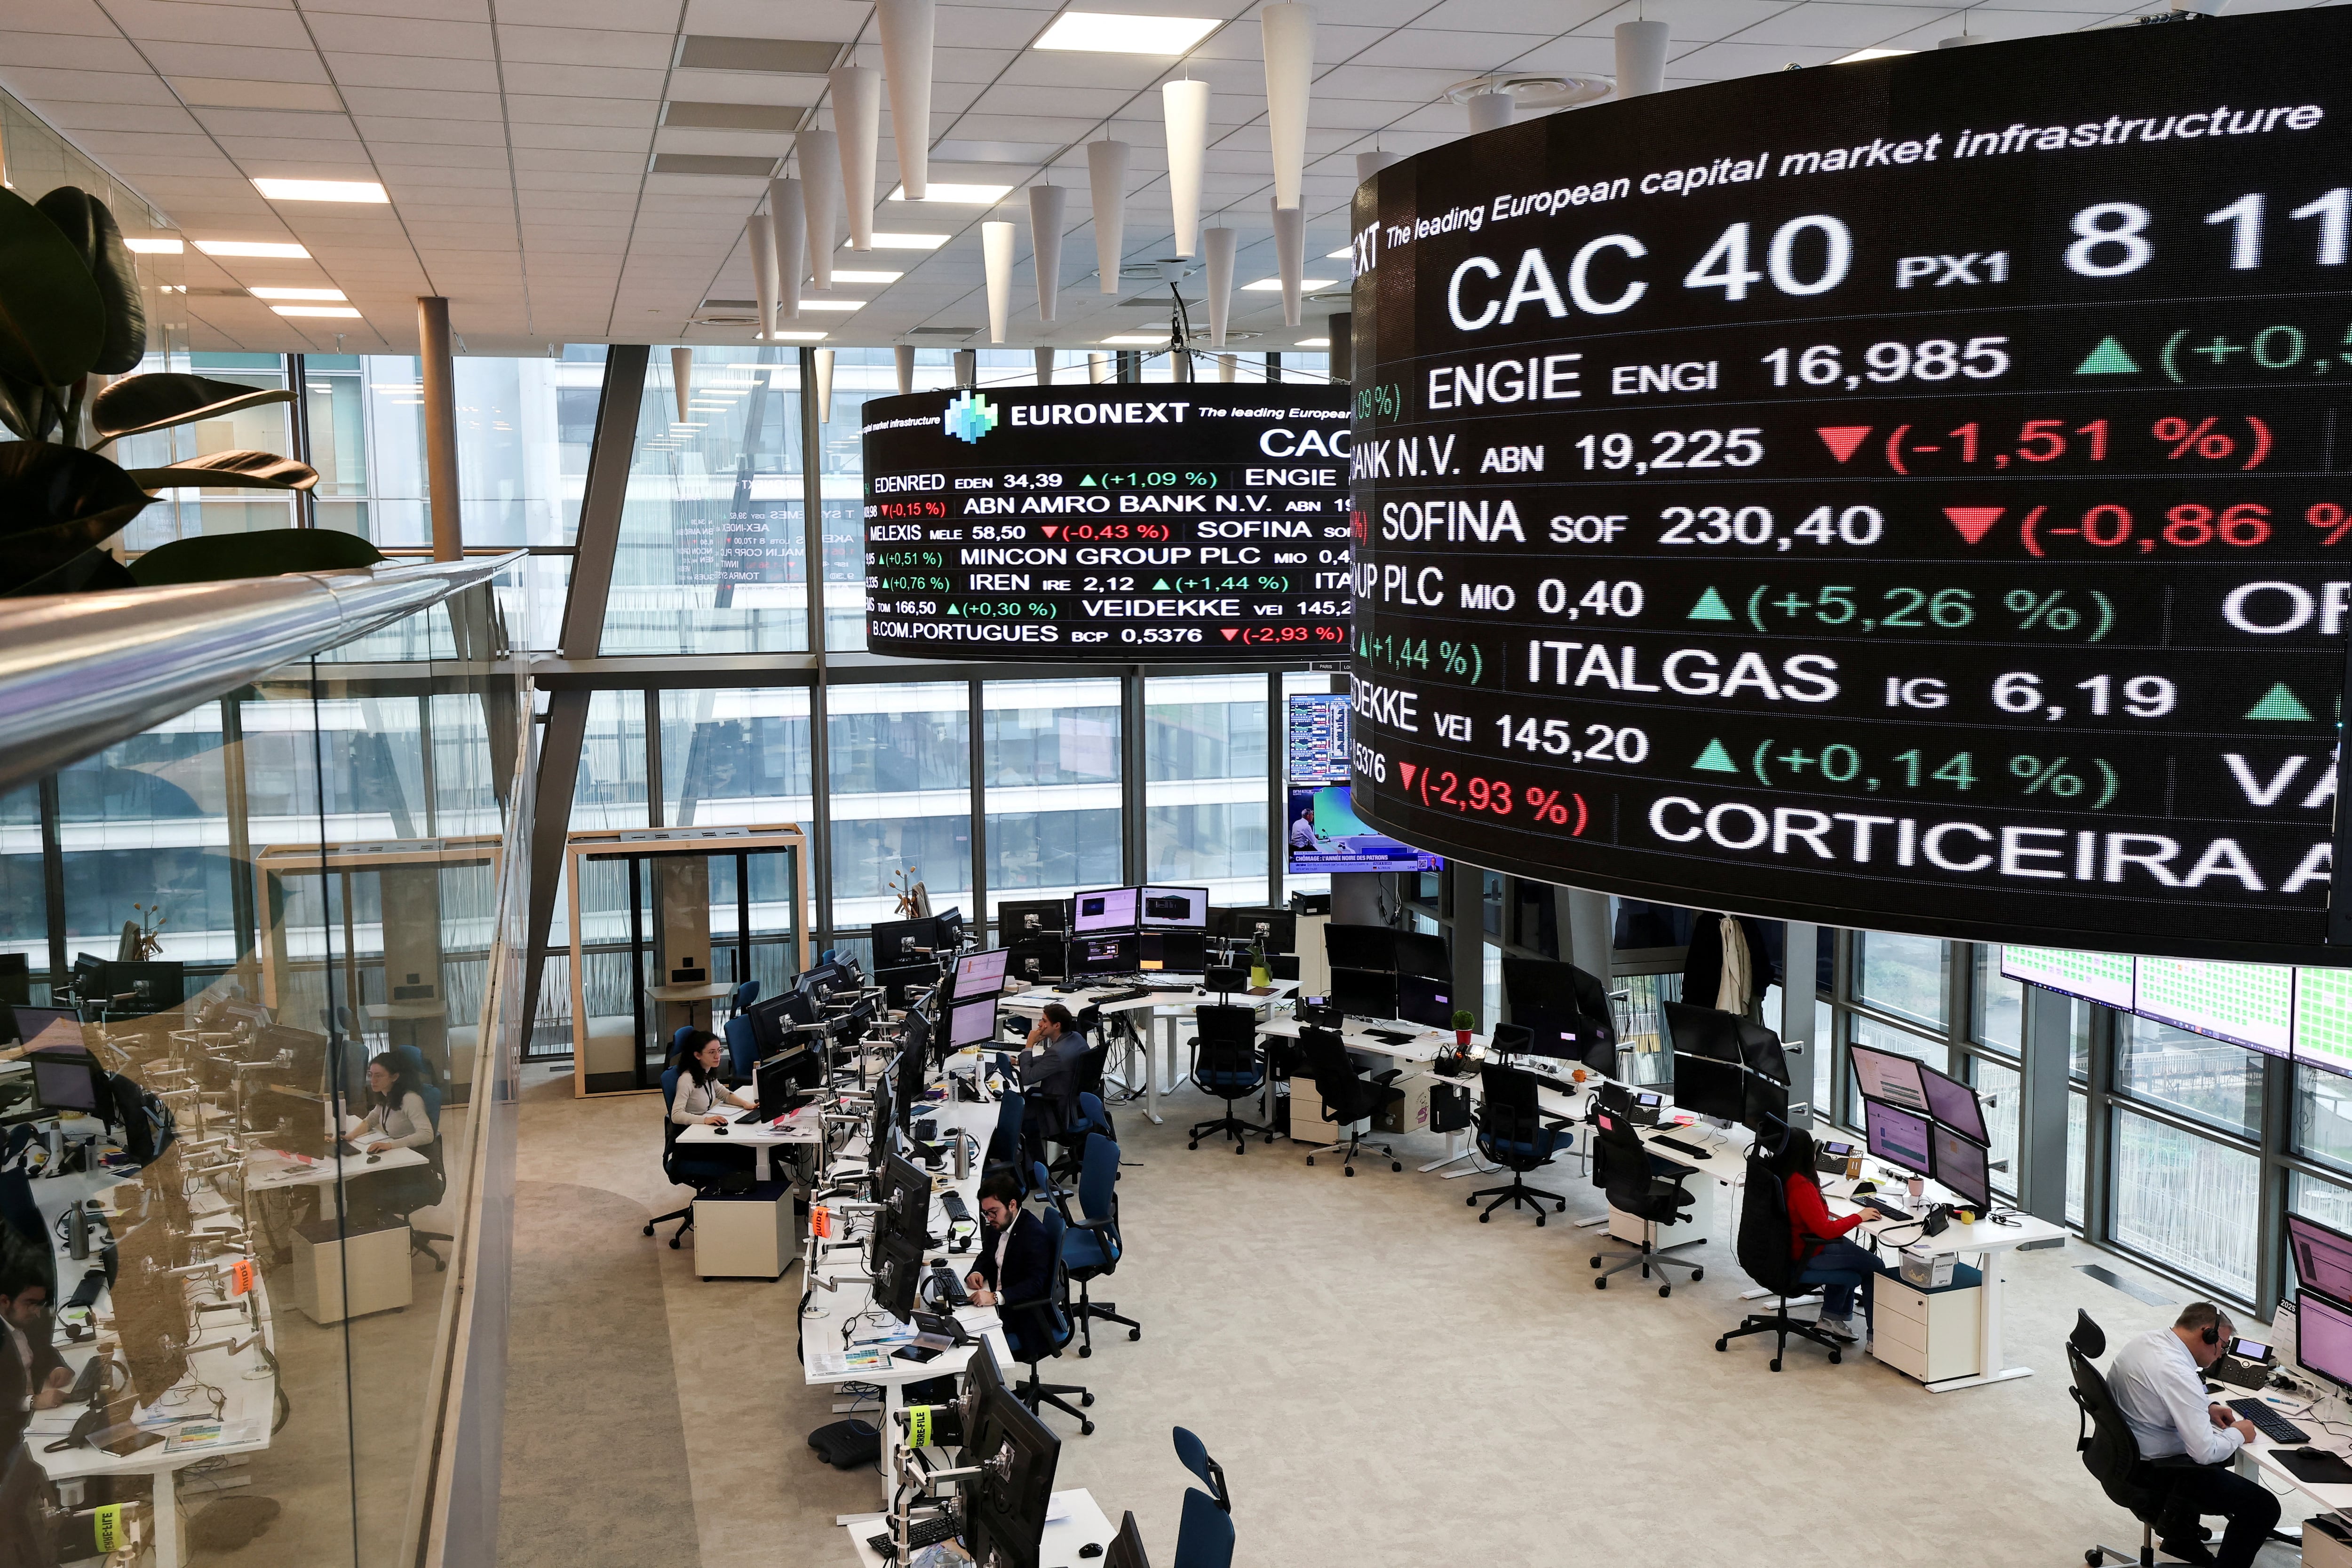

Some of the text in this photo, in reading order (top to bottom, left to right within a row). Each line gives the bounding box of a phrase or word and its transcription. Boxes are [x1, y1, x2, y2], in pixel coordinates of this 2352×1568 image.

[1387, 225, 1411, 249] The
[1414, 204, 1485, 244] leading
[1491, 177, 1630, 216] European
[1640, 152, 1769, 197] capital
[1779, 132, 1943, 177] market
[1954, 104, 2325, 158] infrastructure
[1448, 234, 1648, 331] CAC
[1683, 214, 1853, 301] 40
[1896, 251, 2009, 289] PX1
[2062, 202, 2155, 277] 8
[1375, 384, 1400, 421] %)
[1429, 353, 1583, 409] ENGIE
[1612, 361, 1719, 395] ENGI
[1761, 336, 2010, 391] 16,985
[873, 420, 889, 431] market
[890, 416, 941, 428] infrastructure
[1012, 403, 1190, 426] EURONEXT
[1199, 407, 1227, 417] The
[1231, 408, 1285, 420] leading
[1398, 434, 1460, 476] N.V.
[1480, 446, 1544, 473] ABN
[1575, 428, 1764, 475] 19,225
[1886, 419, 2107, 474] (-1,51
[2152, 416, 2271, 470] %)
[875, 474, 945, 493] EDENRED
[955, 478, 993, 489] EDEN
[1004, 474, 1062, 489] 34,39
[1102, 473, 1176, 489] (+1,09
[1185, 472, 1216, 489] %)
[1246, 469, 1336, 486] ENGIE
[890, 503, 921, 519] (-0,15
[926, 502, 945, 517] %)
[963, 497, 1014, 514] ABN
[1021, 496, 1110, 513] AMRO
[1120, 495, 1206, 512] BANK
[1216, 495, 1271, 511] N.V.
[1285, 501, 1321, 511] ABN
[870, 525, 921, 541] MELEXIS
[930, 530, 962, 539] MELE
[972, 526, 1025, 541] 58,50
[1063, 525, 1129, 542] (-0,43
[1137, 525, 1169, 541] %)
[1197, 521, 1312, 538] SOFINA
[1324, 527, 1350, 537] SO
[1383, 500, 1526, 542] SOFINA
[1549, 515, 1629, 543] SOF
[1658, 506, 1884, 551] 230,40
[2021, 504, 2271, 557] (-0,86
[886, 553, 916, 567] (+0,51
[923, 553, 942, 568] %)
[961, 548, 1066, 564] MINCON
[1076, 548, 1191, 564] GROUP
[1200, 547, 1261, 564] PLC
[1274, 553, 1307, 563] MIO
[891, 577, 925, 591] (+0,76
[930, 578, 949, 593] %)
[970, 574, 1029, 590] IREN
[1043, 580, 1071, 590] IRE
[1084, 577, 1134, 593] 2,12
[1176, 577, 1249, 593] (+1,44
[1258, 577, 1288, 592] %)
[877, 603, 890, 612] TOM
[896, 601, 936, 616] 166,50
[963, 602, 1020, 618] (+0,30
[1029, 603, 1056, 619] %)
[1082, 599, 1240, 616] VEIDEKKE
[1254, 605, 1282, 615] VEI
[1385, 564, 1444, 605] PLC
[1461, 584, 1515, 610] MIO
[1538, 578, 1644, 621] 0,40
[1748, 586, 1976, 631] (+5,26
[2004, 590, 2117, 641] %)
[873, 621, 1058, 641] B.COM.PORTUGUES
[1072, 632, 1108, 642] BCP
[1121, 629, 1202, 644] 0,5376
[1243, 627, 1308, 644] (-2,93
[1315, 627, 1343, 643] %)
[1366, 632, 1430, 670] (+1,44
[1440, 641, 1482, 684] %)
[1529, 640, 1841, 702] ITALGAS
[1885, 676, 1949, 708] IG
[1992, 672, 2179, 723] 6,19
[1434, 712, 1472, 742] VEI
[1496, 715, 1650, 764] 145,20
[1753, 740, 1978, 791] (+0,14
[2008, 755, 2120, 810] %)
[1421, 768, 1512, 814] (-2,93
[1526, 787, 1587, 836] %)
[1649, 796, 2266, 891] CORTICEIRA
[2280, 1299, 2296, 1312] 2025
[915, 1412, 925, 1448] SERRE-FILE
